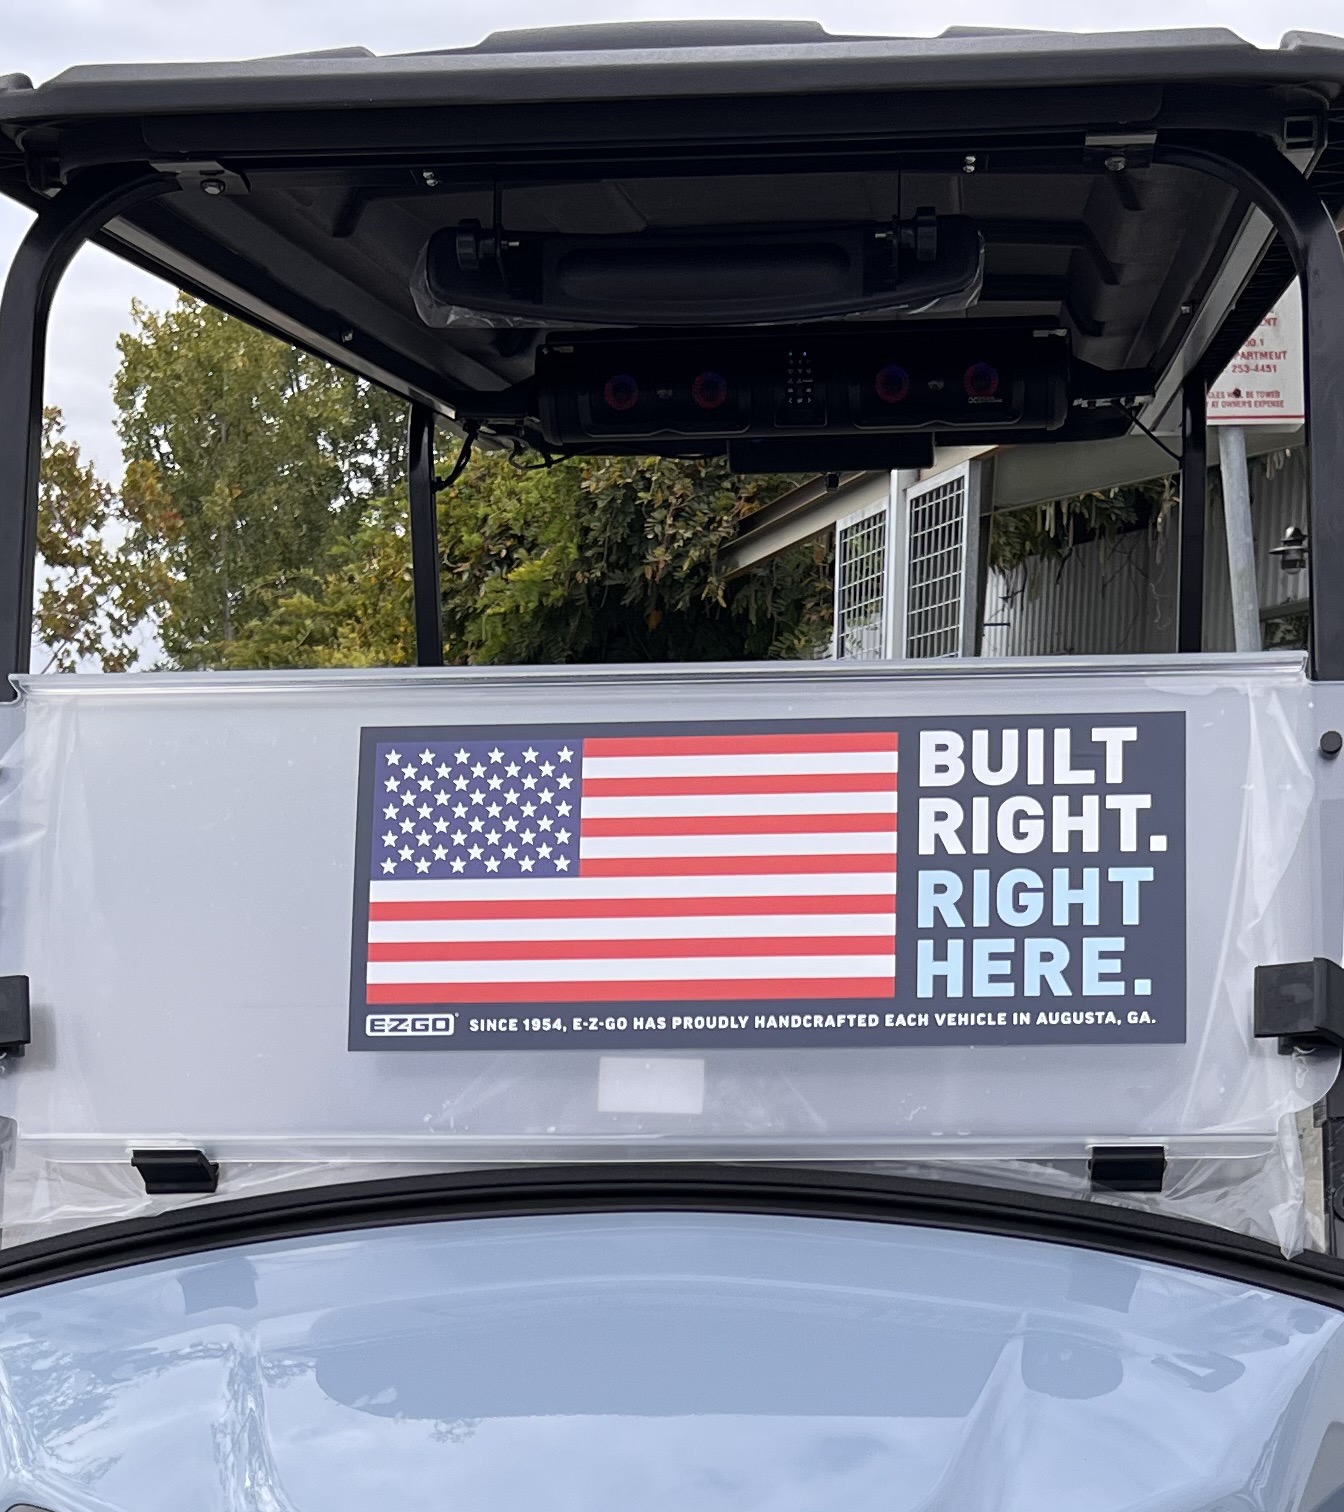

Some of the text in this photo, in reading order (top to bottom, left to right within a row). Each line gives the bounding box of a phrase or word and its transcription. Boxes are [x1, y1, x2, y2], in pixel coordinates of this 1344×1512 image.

[919, 726, 1138, 787] BUILT
[918, 794, 1168, 856] RIGHT.
[917, 866, 1154, 928] RIGHT
[916, 936, 1152, 998] HERE.
[469, 1010, 1157, 1033] SINCE 1954, E-Z-GO HAS PROUDLY HANDCRAFTED EACH VEHICLE IN AUGUSTA, GA.
